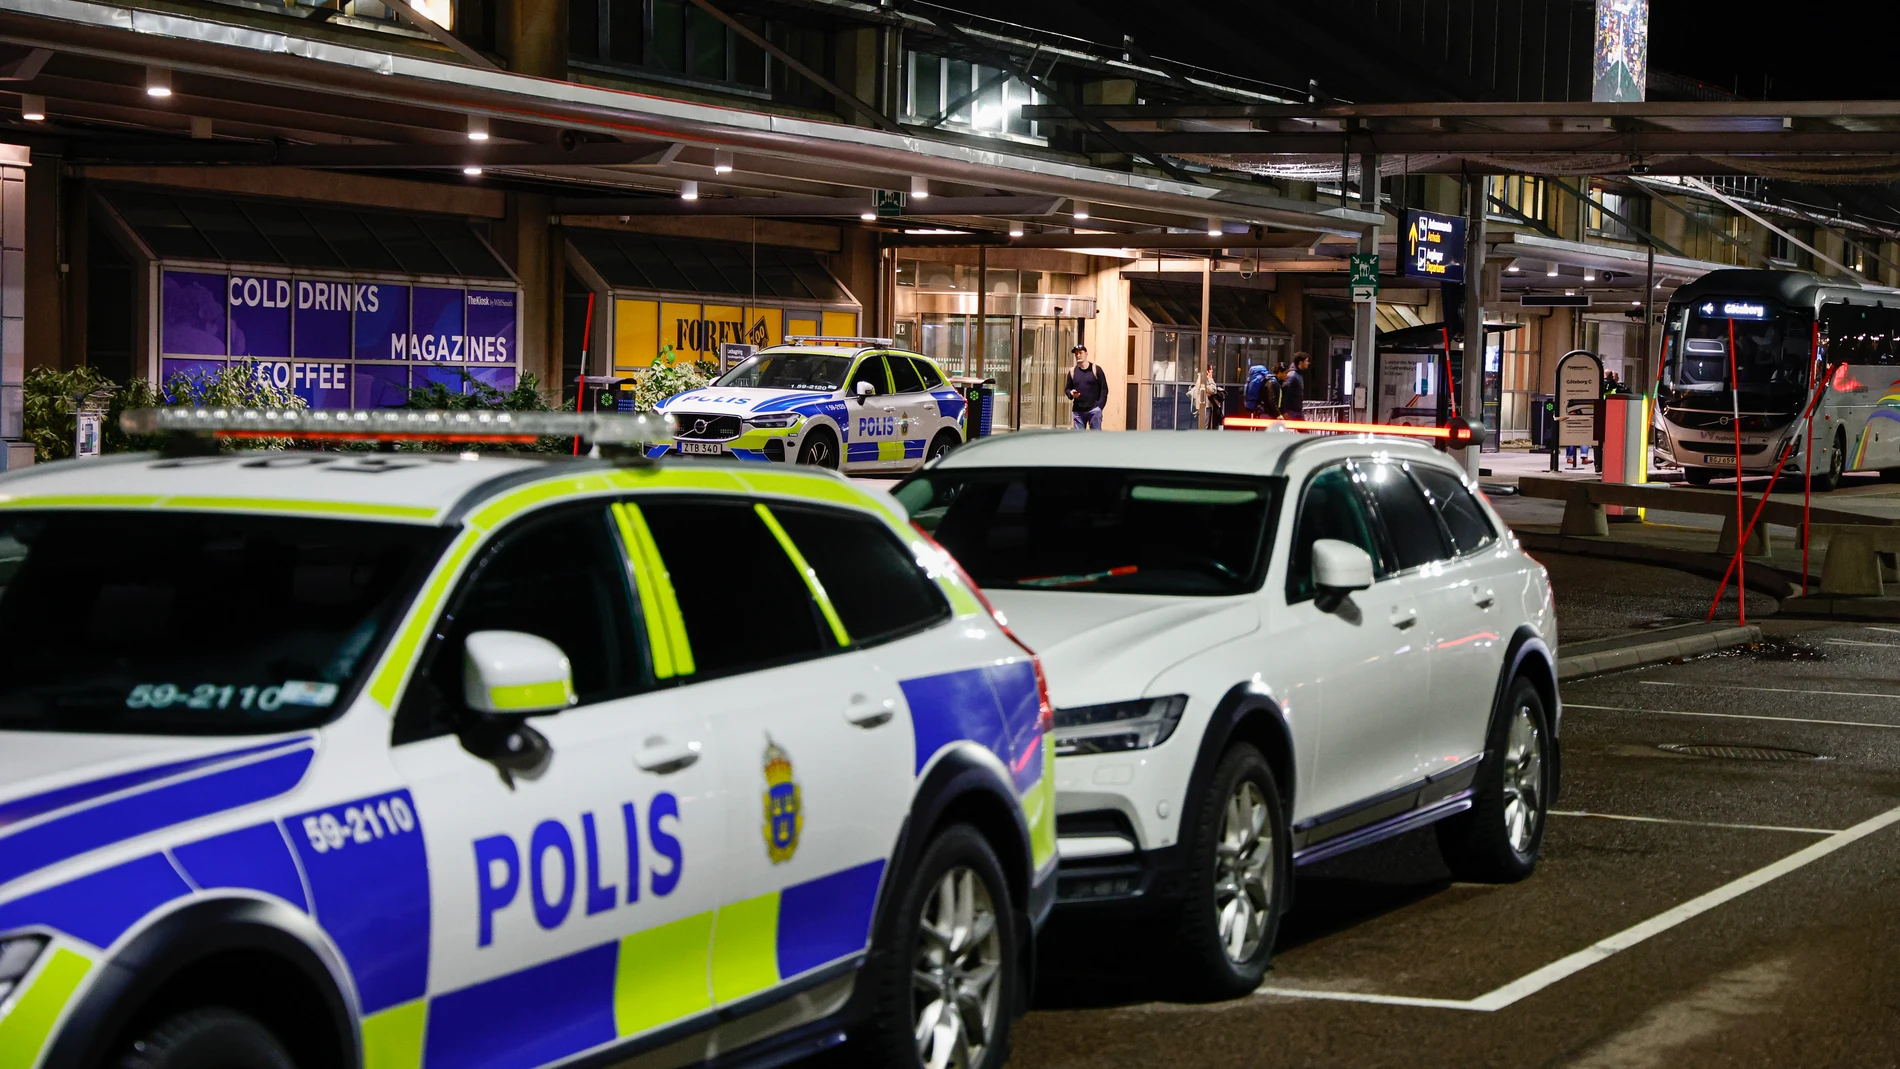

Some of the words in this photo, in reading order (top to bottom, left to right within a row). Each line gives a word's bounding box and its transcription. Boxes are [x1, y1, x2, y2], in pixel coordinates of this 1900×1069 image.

[230, 277, 290, 308] COLD
[298, 281, 379, 313] DRINKS
[391, 333, 507, 362] MAGAZINES
[676, 318, 746, 354] FOREX
[257, 362, 346, 390] COFFEE
[859, 416, 894, 437] POLIS
[684, 443, 699, 453] ZTB
[702, 444, 718, 454] 340
[126, 683, 284, 712] 59-2110
[302, 797, 414, 854] 59-2110
[473, 792, 684, 948] POLIS
